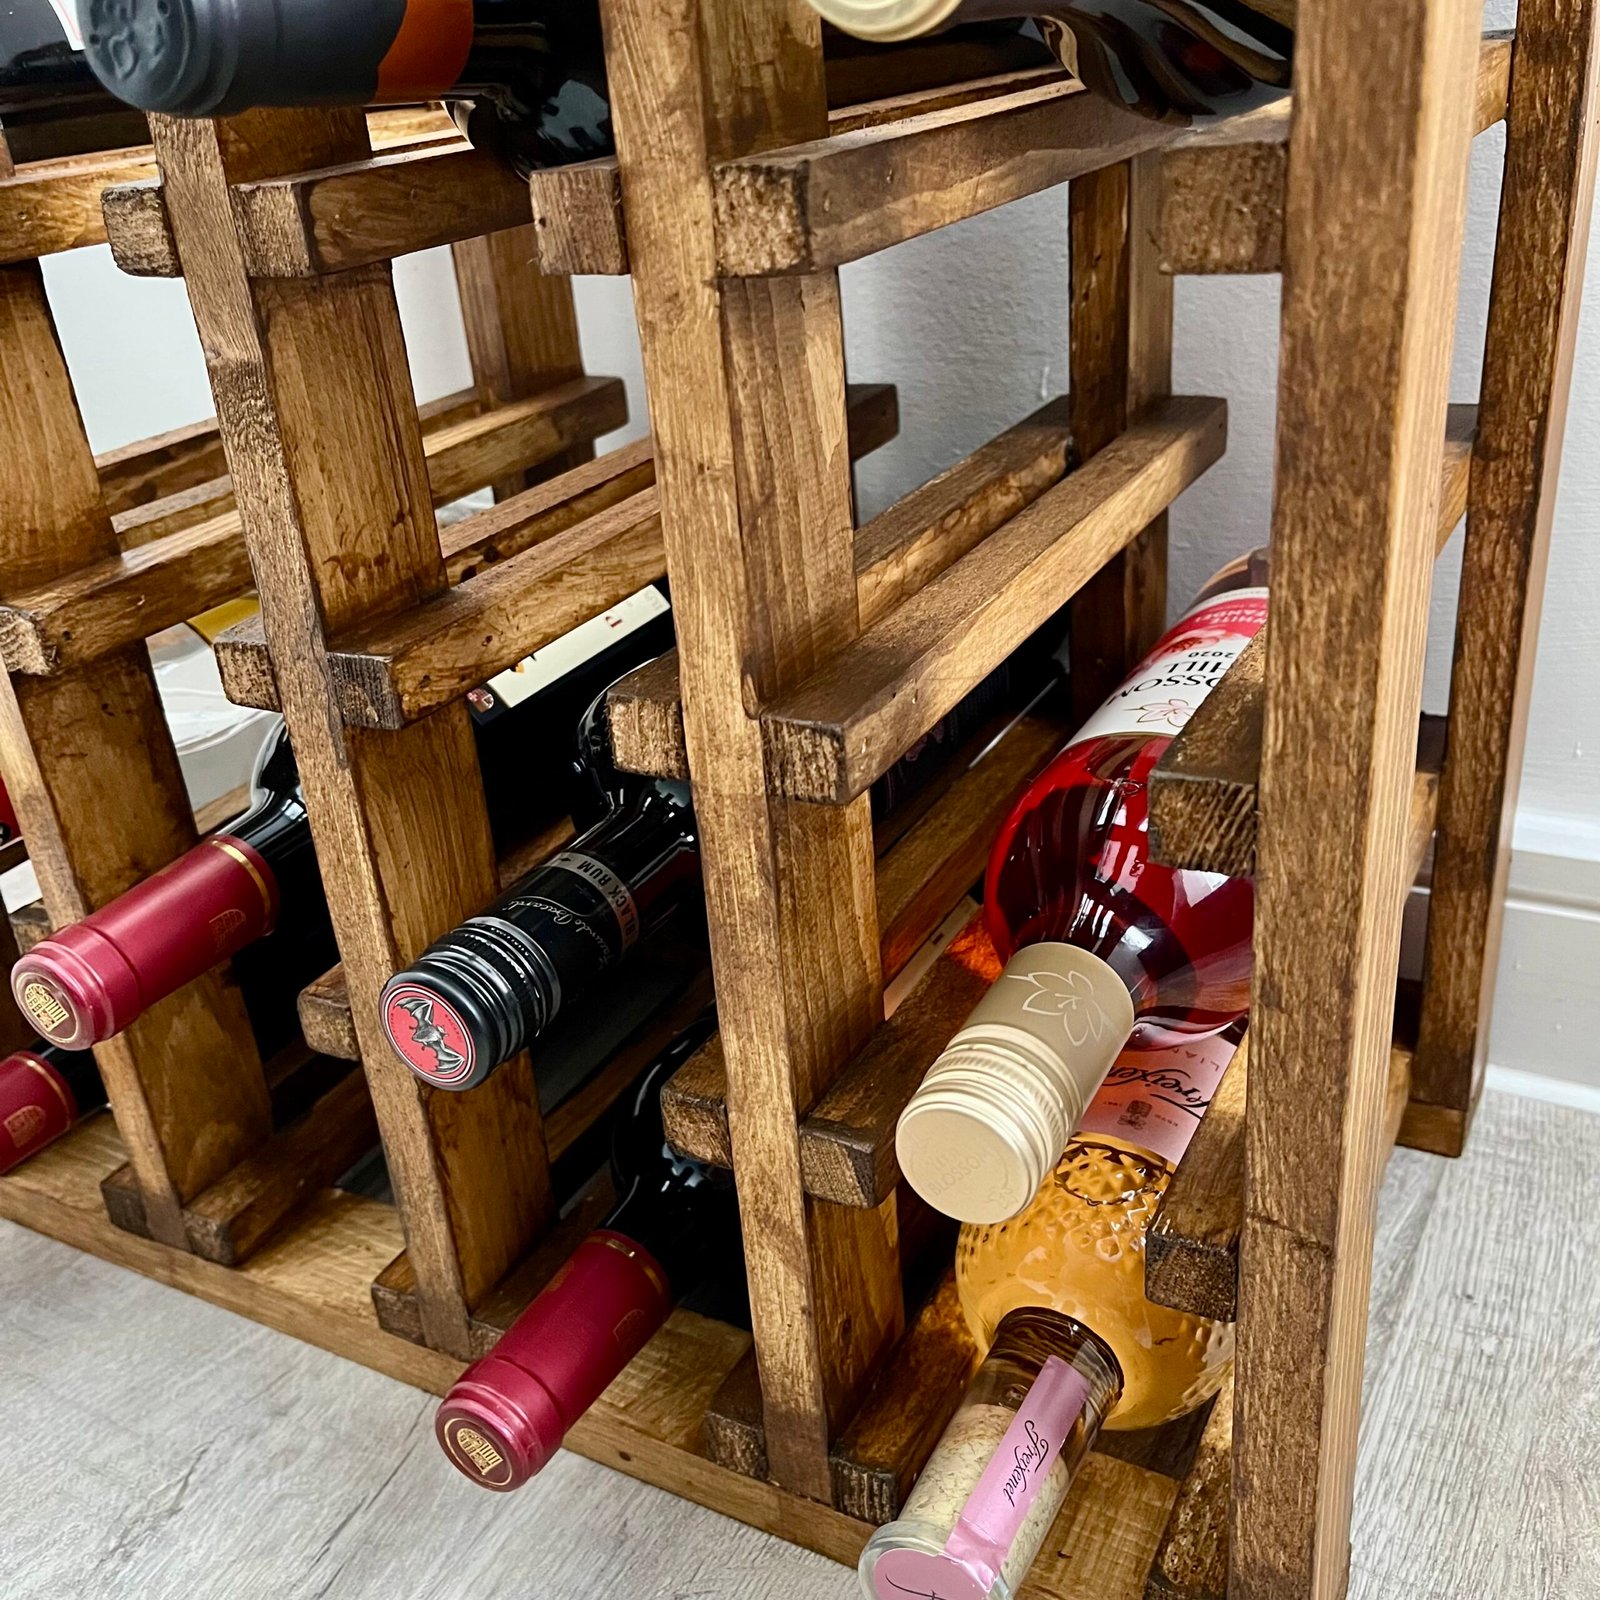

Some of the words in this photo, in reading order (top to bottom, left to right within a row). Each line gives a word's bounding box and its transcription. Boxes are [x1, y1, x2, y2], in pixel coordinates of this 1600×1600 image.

[1188, 651, 1236, 659] 2020
[1105, 674, 1222, 706] OSSOM
[576, 859, 612, 888] RUM
[608, 884, 635, 937] BLACK
[1003, 1420, 1049, 1508] Freixenet
